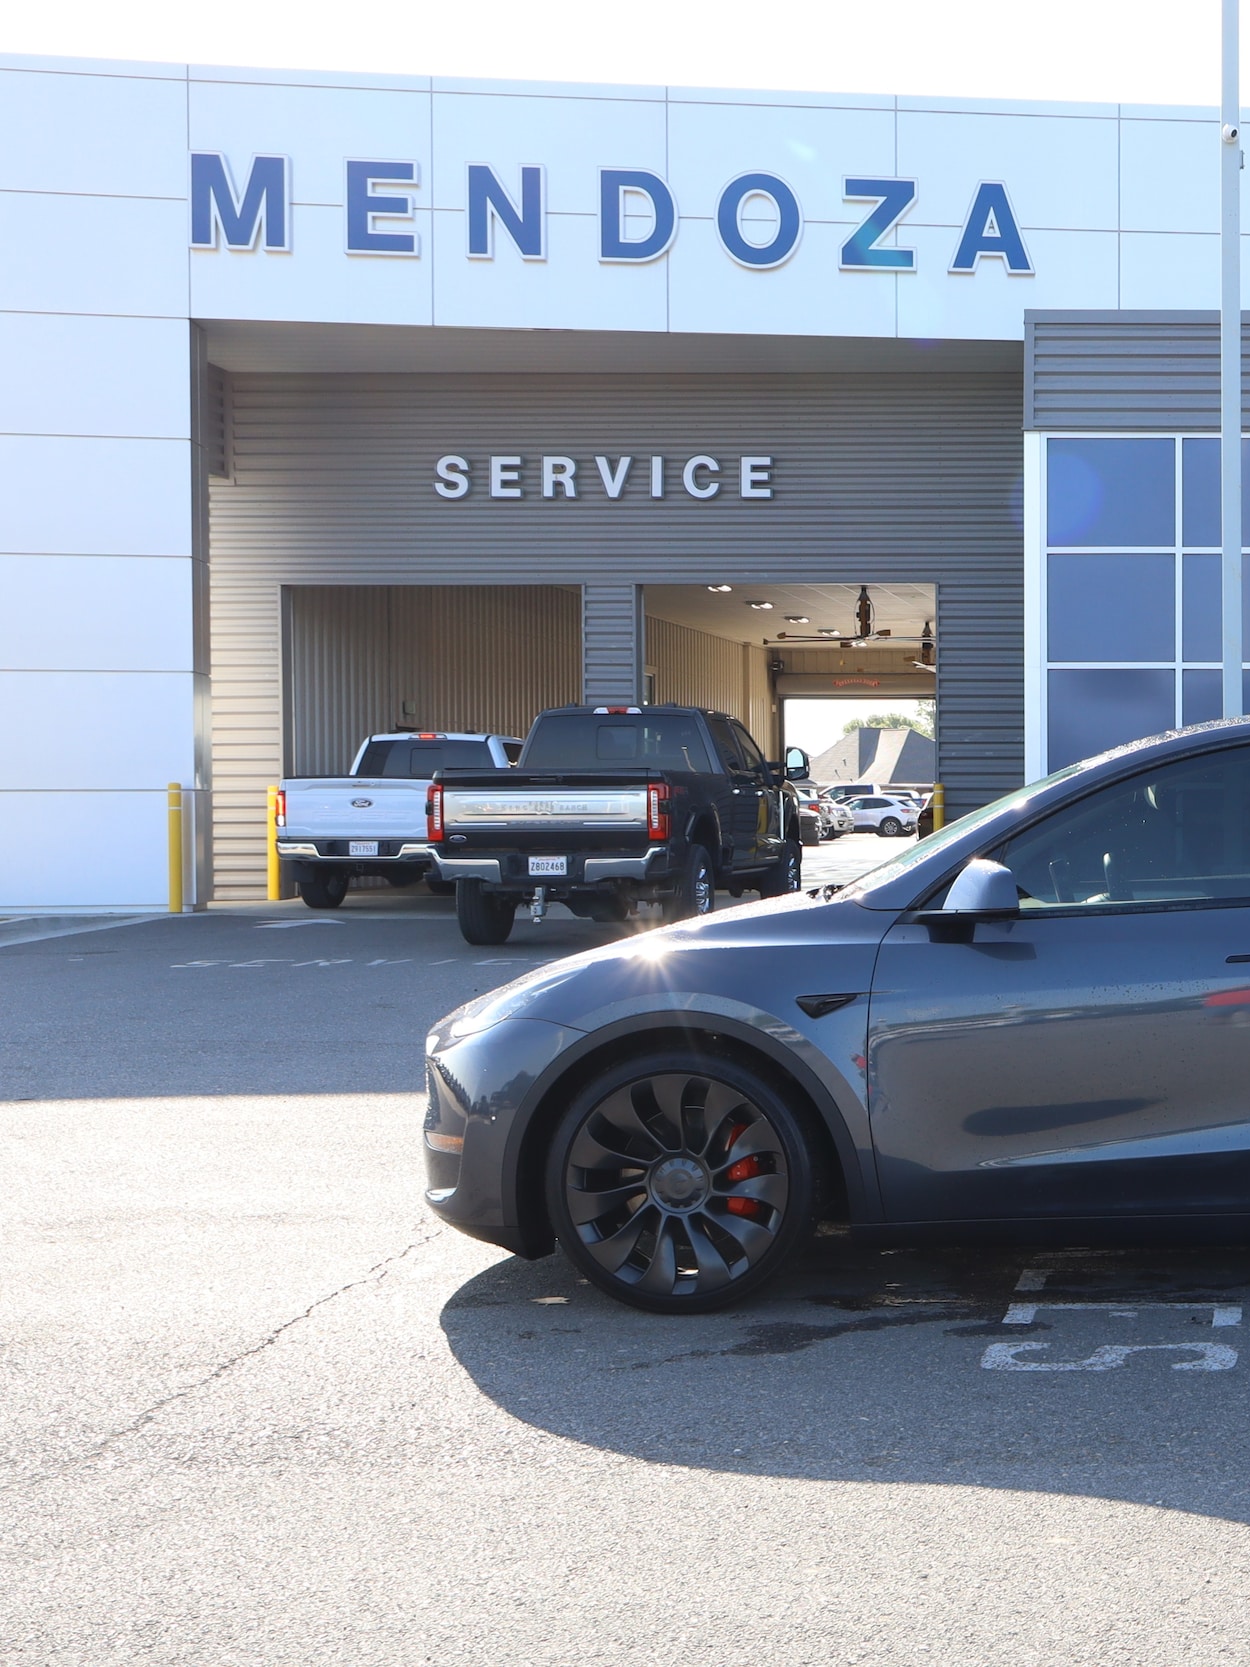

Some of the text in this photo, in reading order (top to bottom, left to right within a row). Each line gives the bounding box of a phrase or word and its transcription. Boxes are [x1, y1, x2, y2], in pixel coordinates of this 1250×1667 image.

[189, 150, 1036, 275] MENDOZA
[434, 454, 775, 501] SERVICE
[530, 862, 565, 871] Z802468
